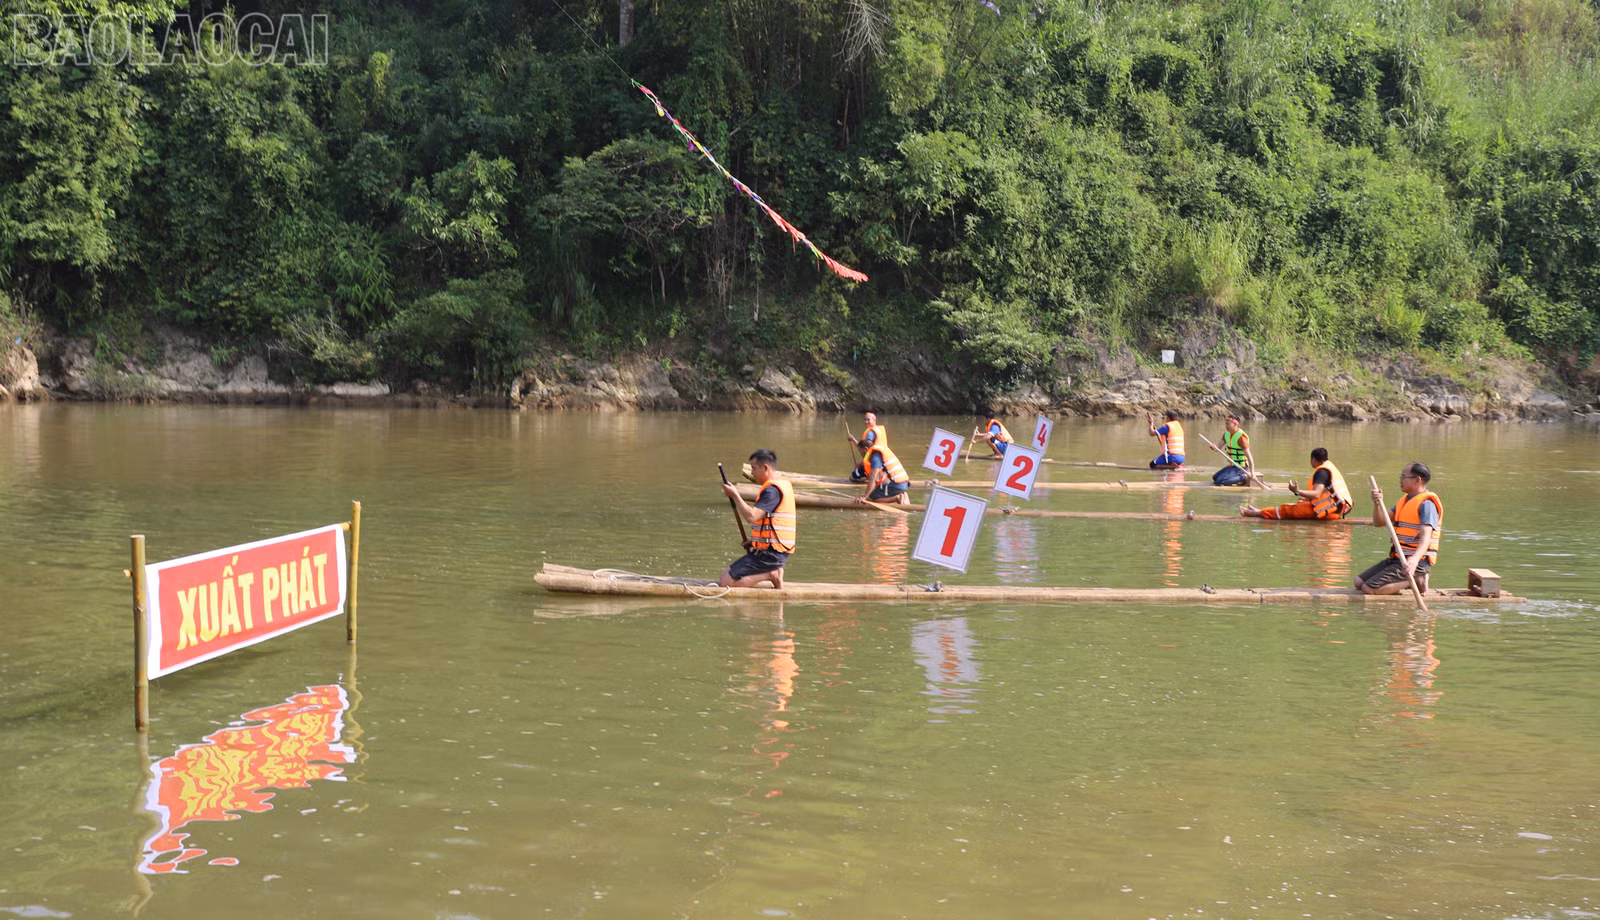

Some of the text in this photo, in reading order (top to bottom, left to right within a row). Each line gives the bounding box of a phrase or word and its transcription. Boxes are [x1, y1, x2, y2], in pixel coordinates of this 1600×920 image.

[1037, 423, 1047, 446] 4
[934, 439, 956, 467] 3
[1006, 456, 1034, 491] 2
[940, 506, 967, 557] 1
[177, 546, 327, 651] XUẤT PHÁT
